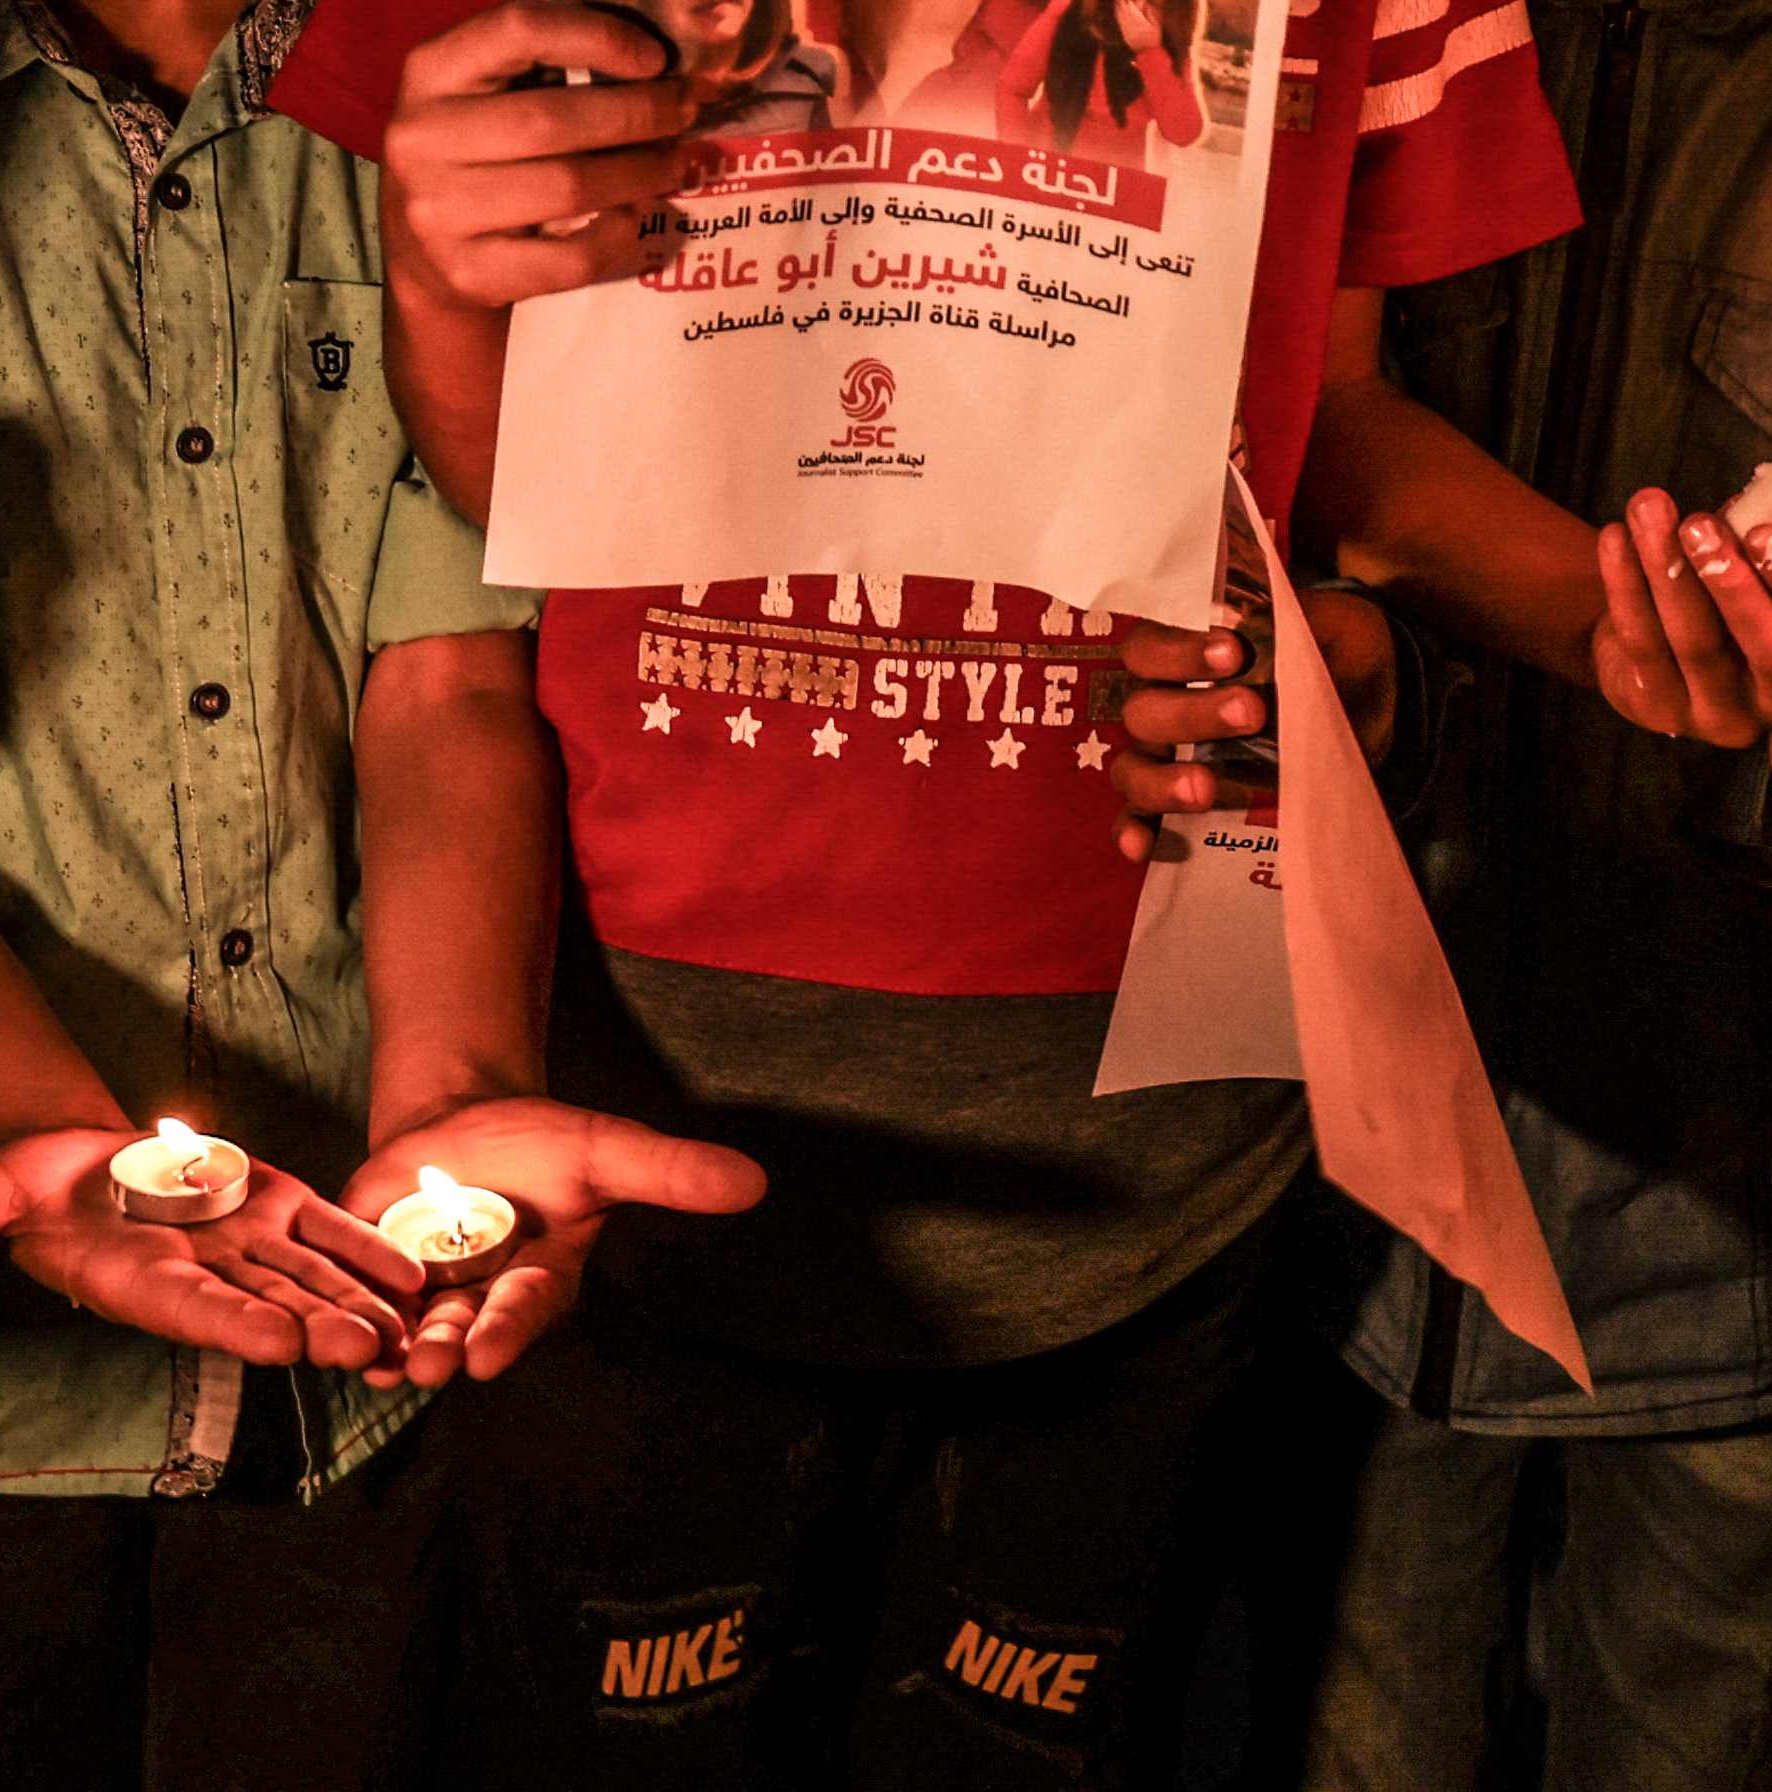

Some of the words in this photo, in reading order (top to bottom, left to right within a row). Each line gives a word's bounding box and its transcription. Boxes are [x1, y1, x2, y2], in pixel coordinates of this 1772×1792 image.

[680, 129, 893, 198] الصحفيين
[907, 147, 1004, 183] دعم
[1022, 149, 1118, 210] لجنة
[674, 206, 750, 239] العربية
[758, 197, 814, 225] الأمة
[820, 196, 875, 225] وإلى
[884, 196, 993, 230] الصحفية
[1001, 213, 1081, 246] الأسرة
[777, 229, 838, 293] أبو
[1088, 235, 1128, 265] إلى
[1136, 255, 1195, 278] تنعى
[638, 247, 758, 292] عاقلة
[851, 242, 1007, 294] شيرين
[1017, 273, 1130, 317] الصحافية
[683, 304, 784, 340] فلسطين
[792, 302, 830, 332] في
[838, 300, 921, 327] الجزيرة
[929, 304, 980, 329] قناة
[989, 311, 1076, 348] مراسلة
[830, 425, 897, 448] JSC
[871, 657, 1078, 726] STYLE
[1204, 832, 1278, 853] الزميلة
[602, 1609, 745, 1698] NIKE
[943, 1620, 1098, 1714] NIKE
